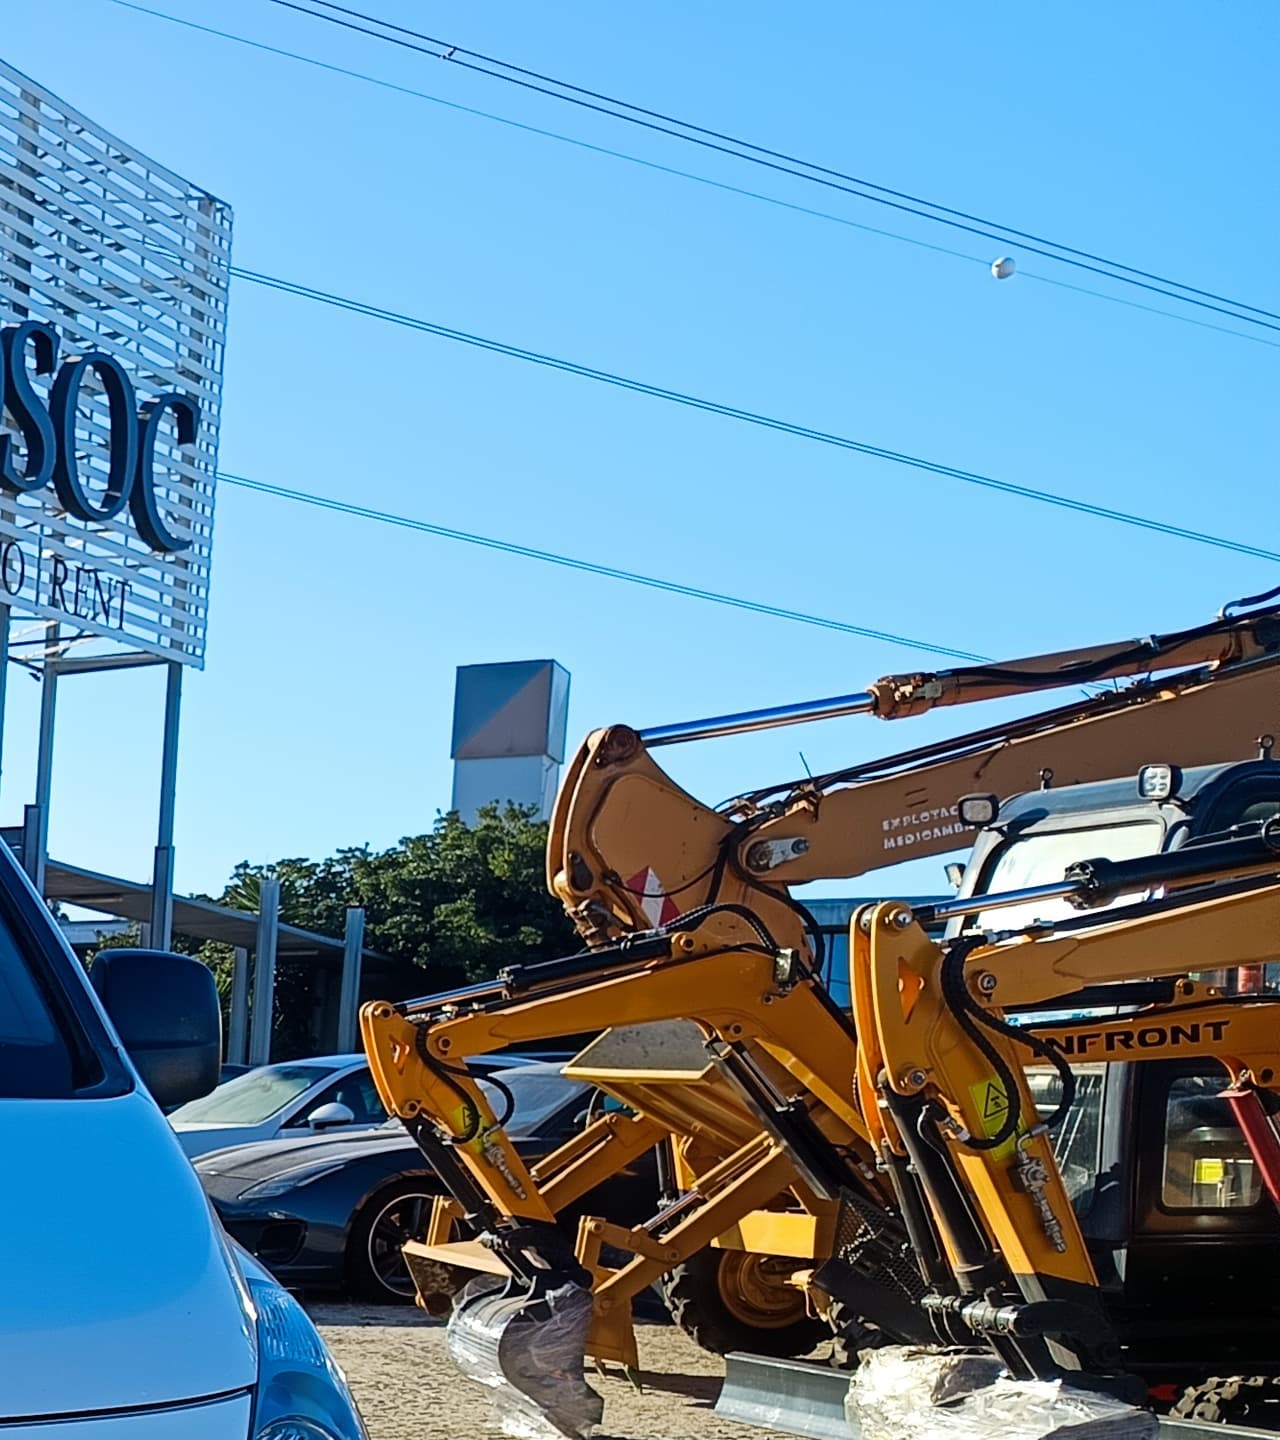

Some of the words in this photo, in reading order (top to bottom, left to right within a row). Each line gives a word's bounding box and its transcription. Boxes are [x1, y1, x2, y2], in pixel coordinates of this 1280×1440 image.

[48, 553, 133, 631] RENT
[882, 805, 959, 831] EXPLOTAC
[884, 822, 965, 849] MEDIOAMB
